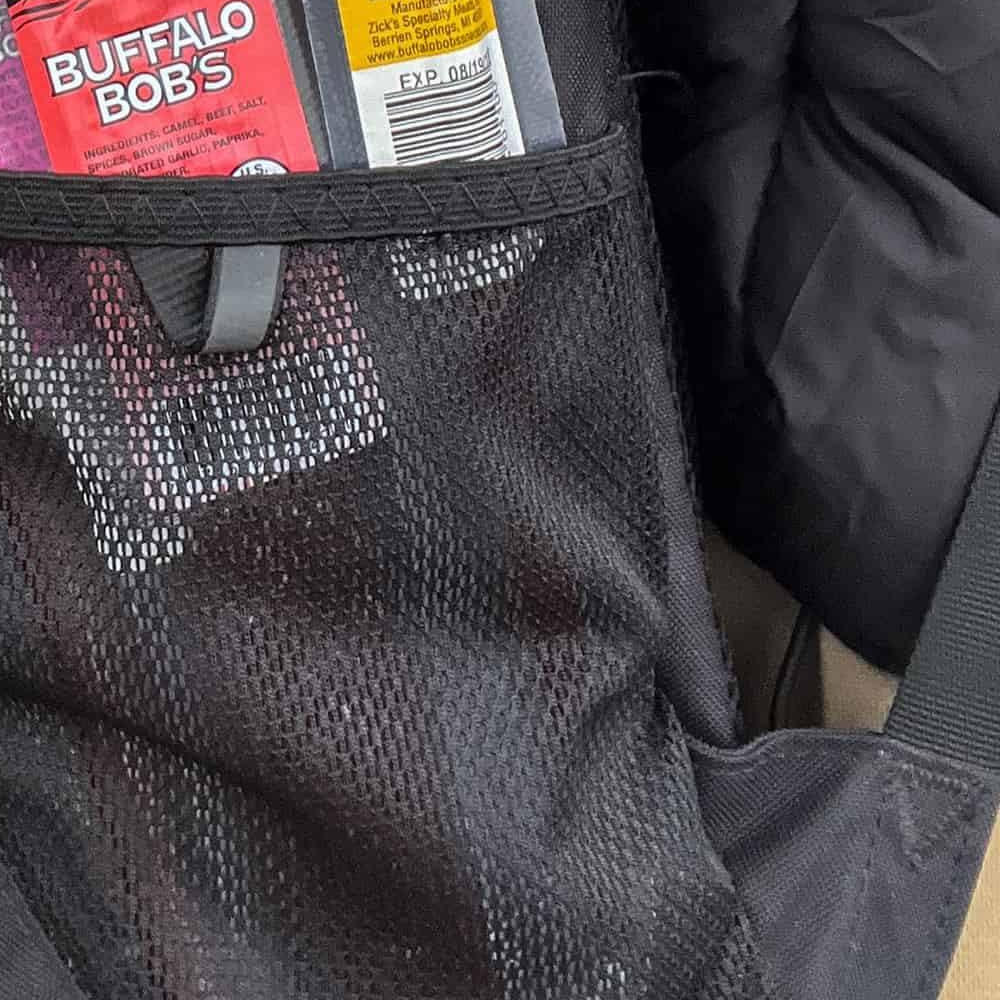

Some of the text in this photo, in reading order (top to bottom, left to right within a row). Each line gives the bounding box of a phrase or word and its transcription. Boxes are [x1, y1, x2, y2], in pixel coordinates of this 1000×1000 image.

[368, 14, 400, 34] Zick's
[403, 4, 451, 28] Specialty
[372, 32, 412, 49] Berrien
[91, 49, 235, 126] BOB'S
[83, 129, 160, 161] INGREDIENTS:
[132, 141, 175, 160] BROWN
